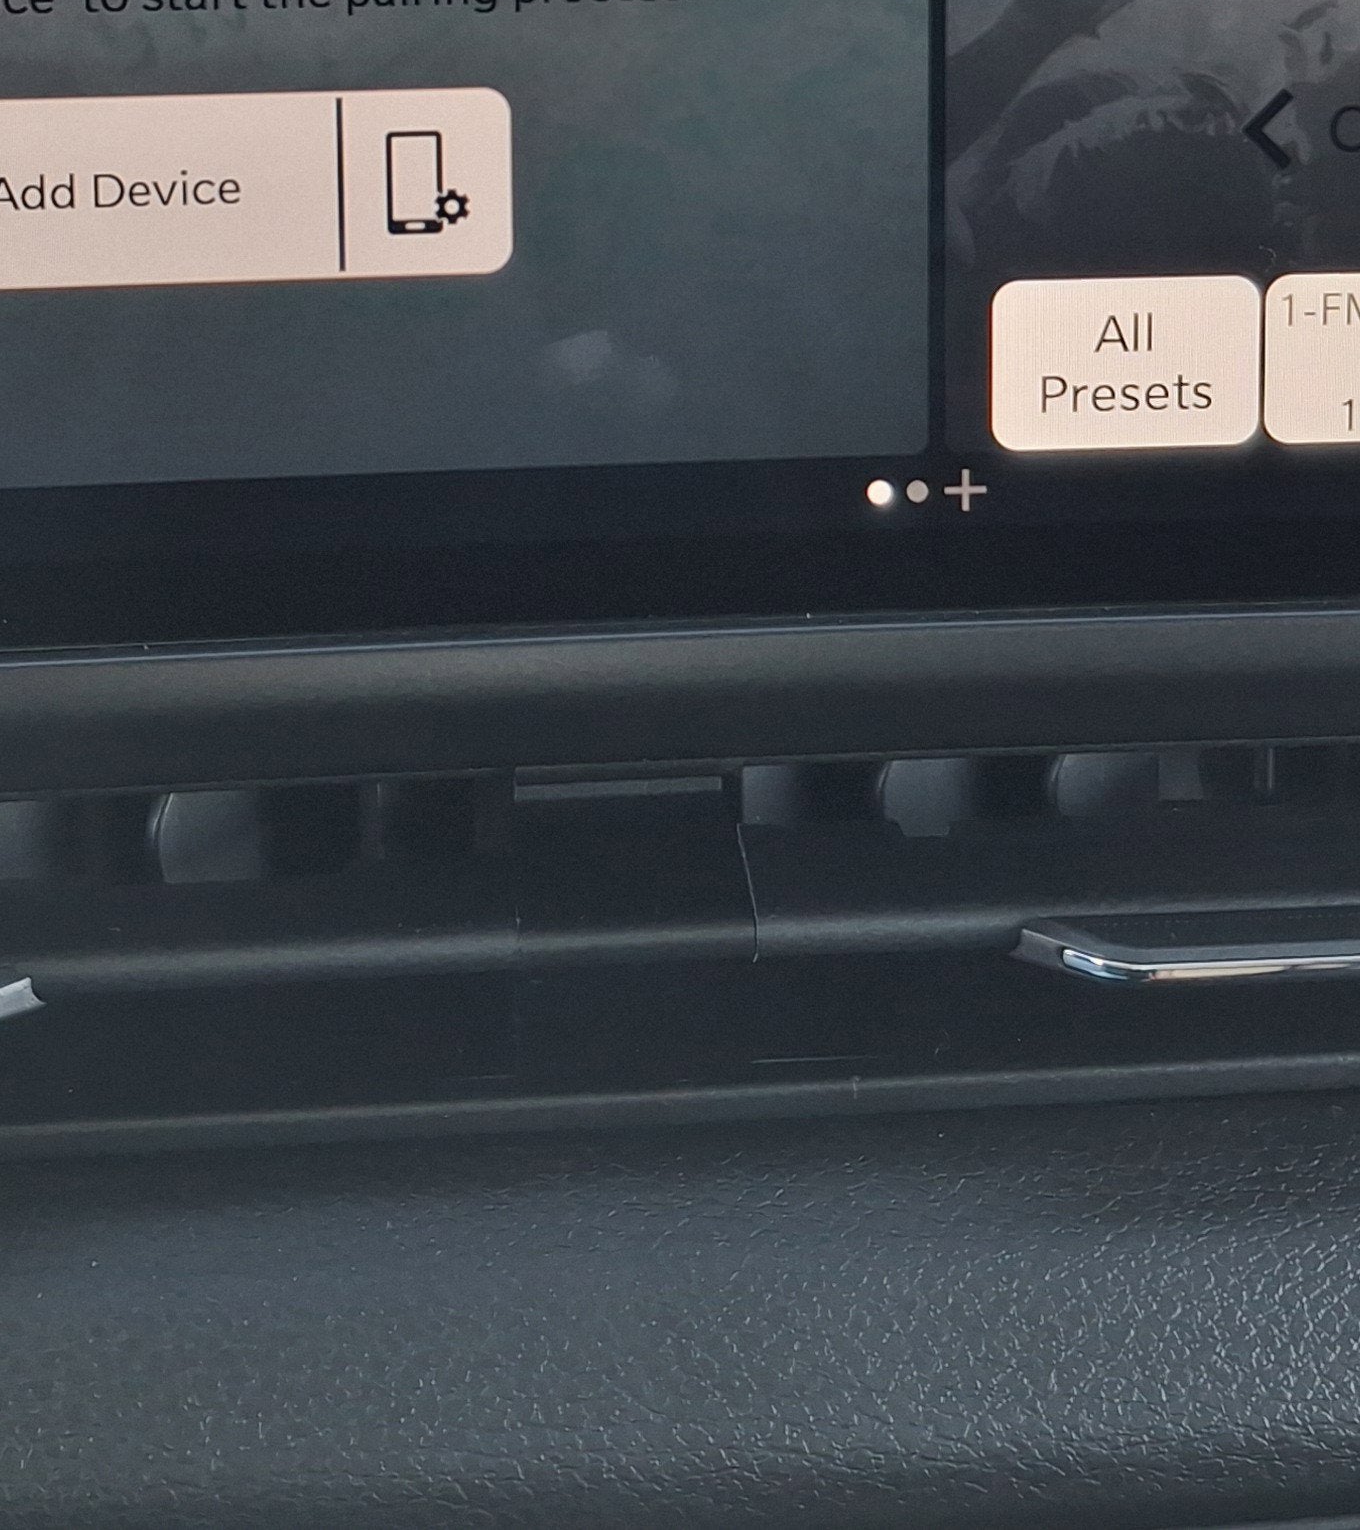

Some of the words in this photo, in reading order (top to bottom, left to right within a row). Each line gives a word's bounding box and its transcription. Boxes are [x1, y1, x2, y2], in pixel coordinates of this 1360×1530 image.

[93, 169, 242, 209] Device
[1094, 313, 1154, 353] All
[1040, 374, 1213, 413] Presets
